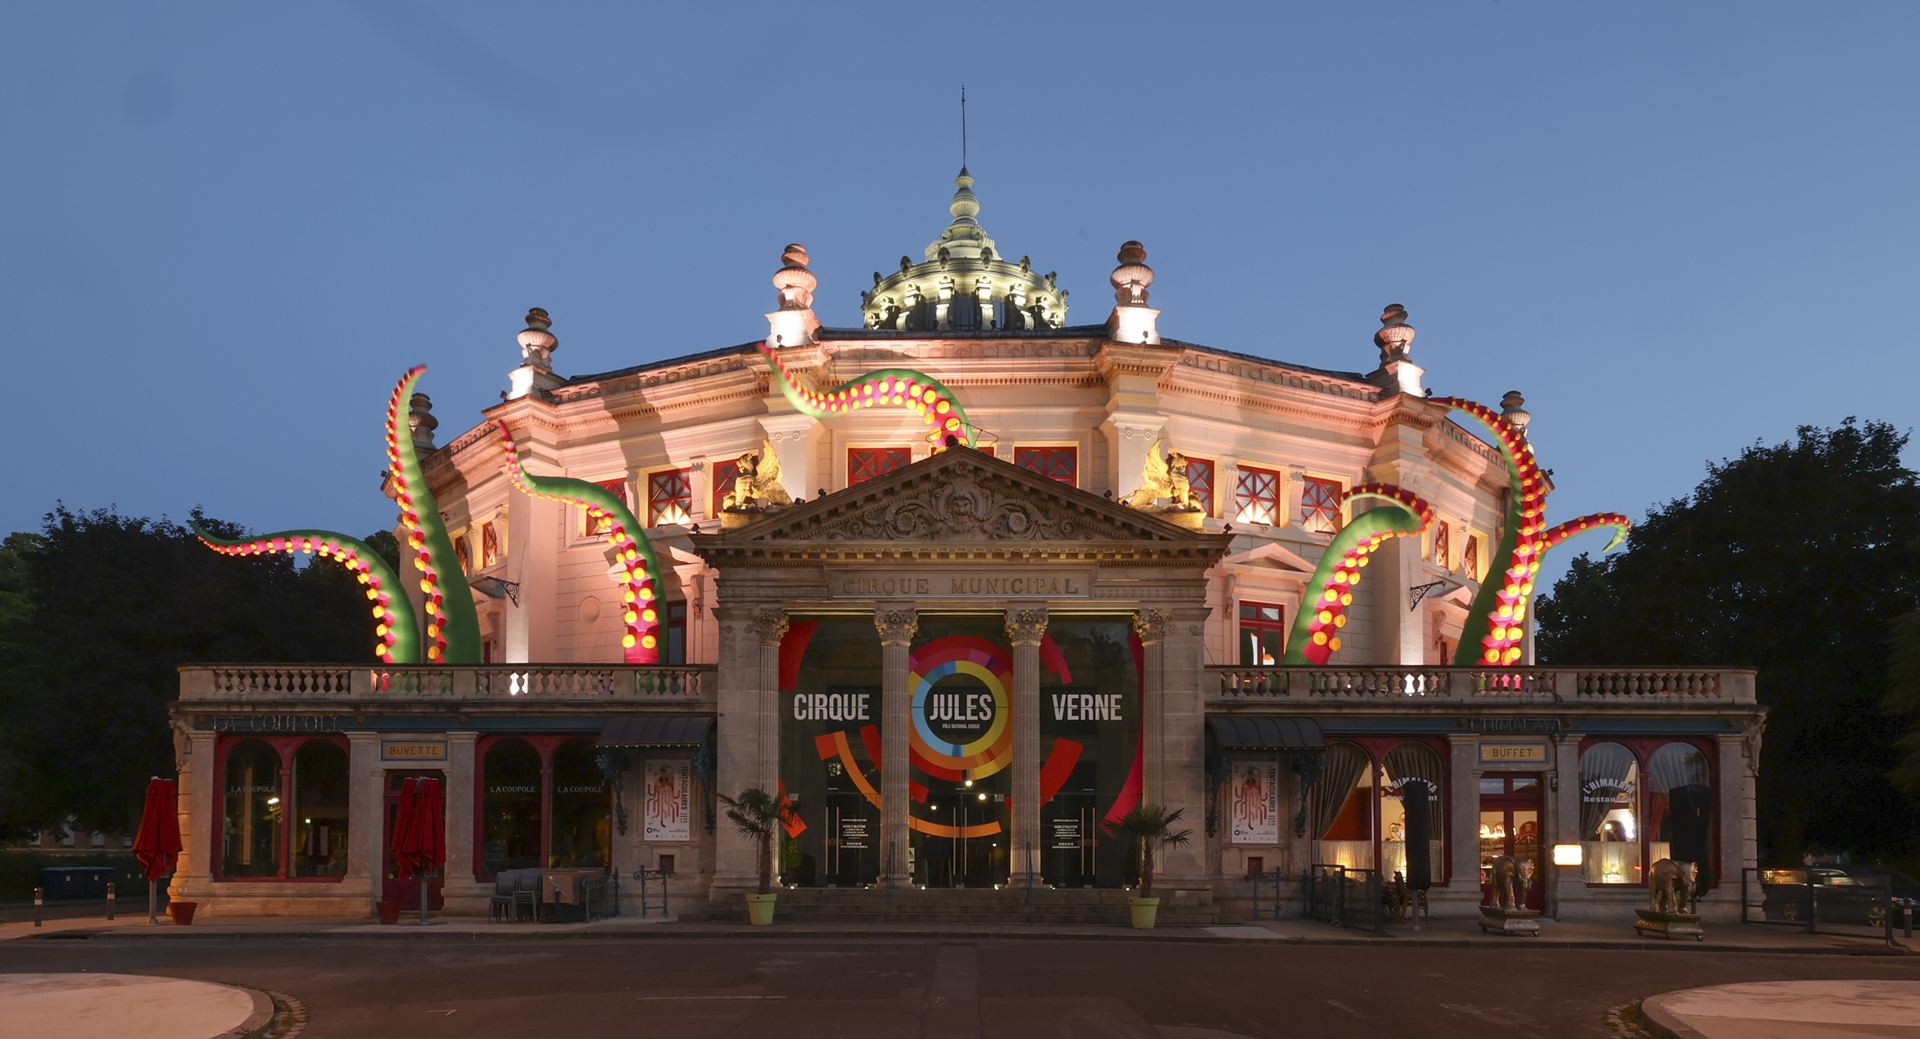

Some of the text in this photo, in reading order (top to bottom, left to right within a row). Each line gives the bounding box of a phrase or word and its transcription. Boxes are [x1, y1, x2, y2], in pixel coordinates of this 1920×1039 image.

[842, 577, 1079, 596] CIRQUE MUNICIPAL
[793, 693, 871, 721] CIRQUE
[929, 693, 992, 721] JULES
[1051, 693, 1123, 721] VERNE
[389, 746, 439, 756] BUVETTE
[1492, 748, 1533, 758] BUFFET
[490, 785, 536, 793] LA COUPOLE
[557, 785, 603, 793] LA COUPOLE
[680, 766, 688, 810] TENTACULAIRES
